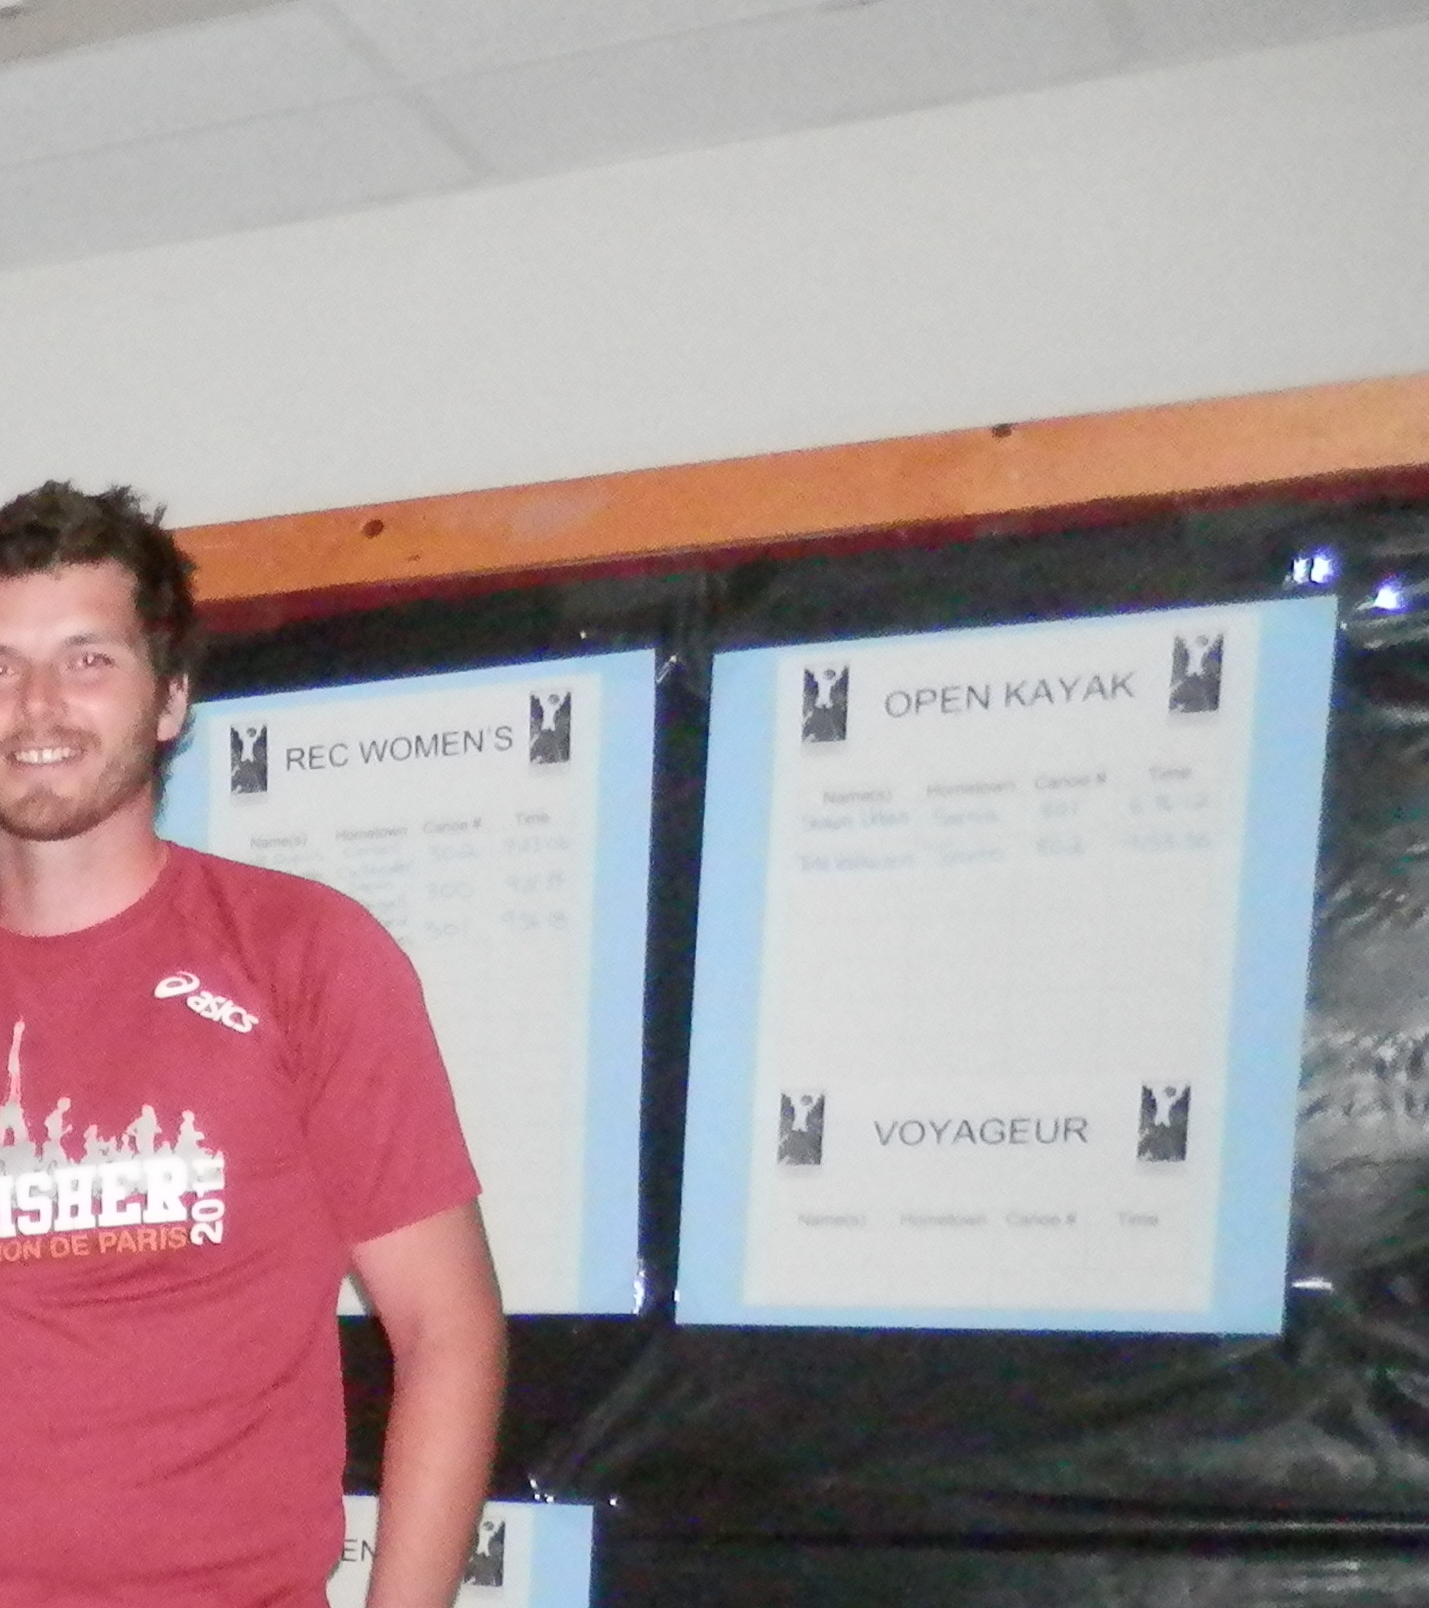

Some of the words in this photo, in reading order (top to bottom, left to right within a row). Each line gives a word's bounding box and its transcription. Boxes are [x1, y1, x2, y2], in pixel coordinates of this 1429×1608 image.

[884, 683, 991, 718] OPEN
[1004, 672, 1137, 708] KAYAK
[285, 743, 349, 771] REC
[359, 726, 514, 765] WOMEN'S
[186, 990, 260, 1033] asics
[873, 1116, 1090, 1148] VOYAGEUR
[49, 1234, 89, 1258] DE
[99, 1226, 189, 1254] PARIS
